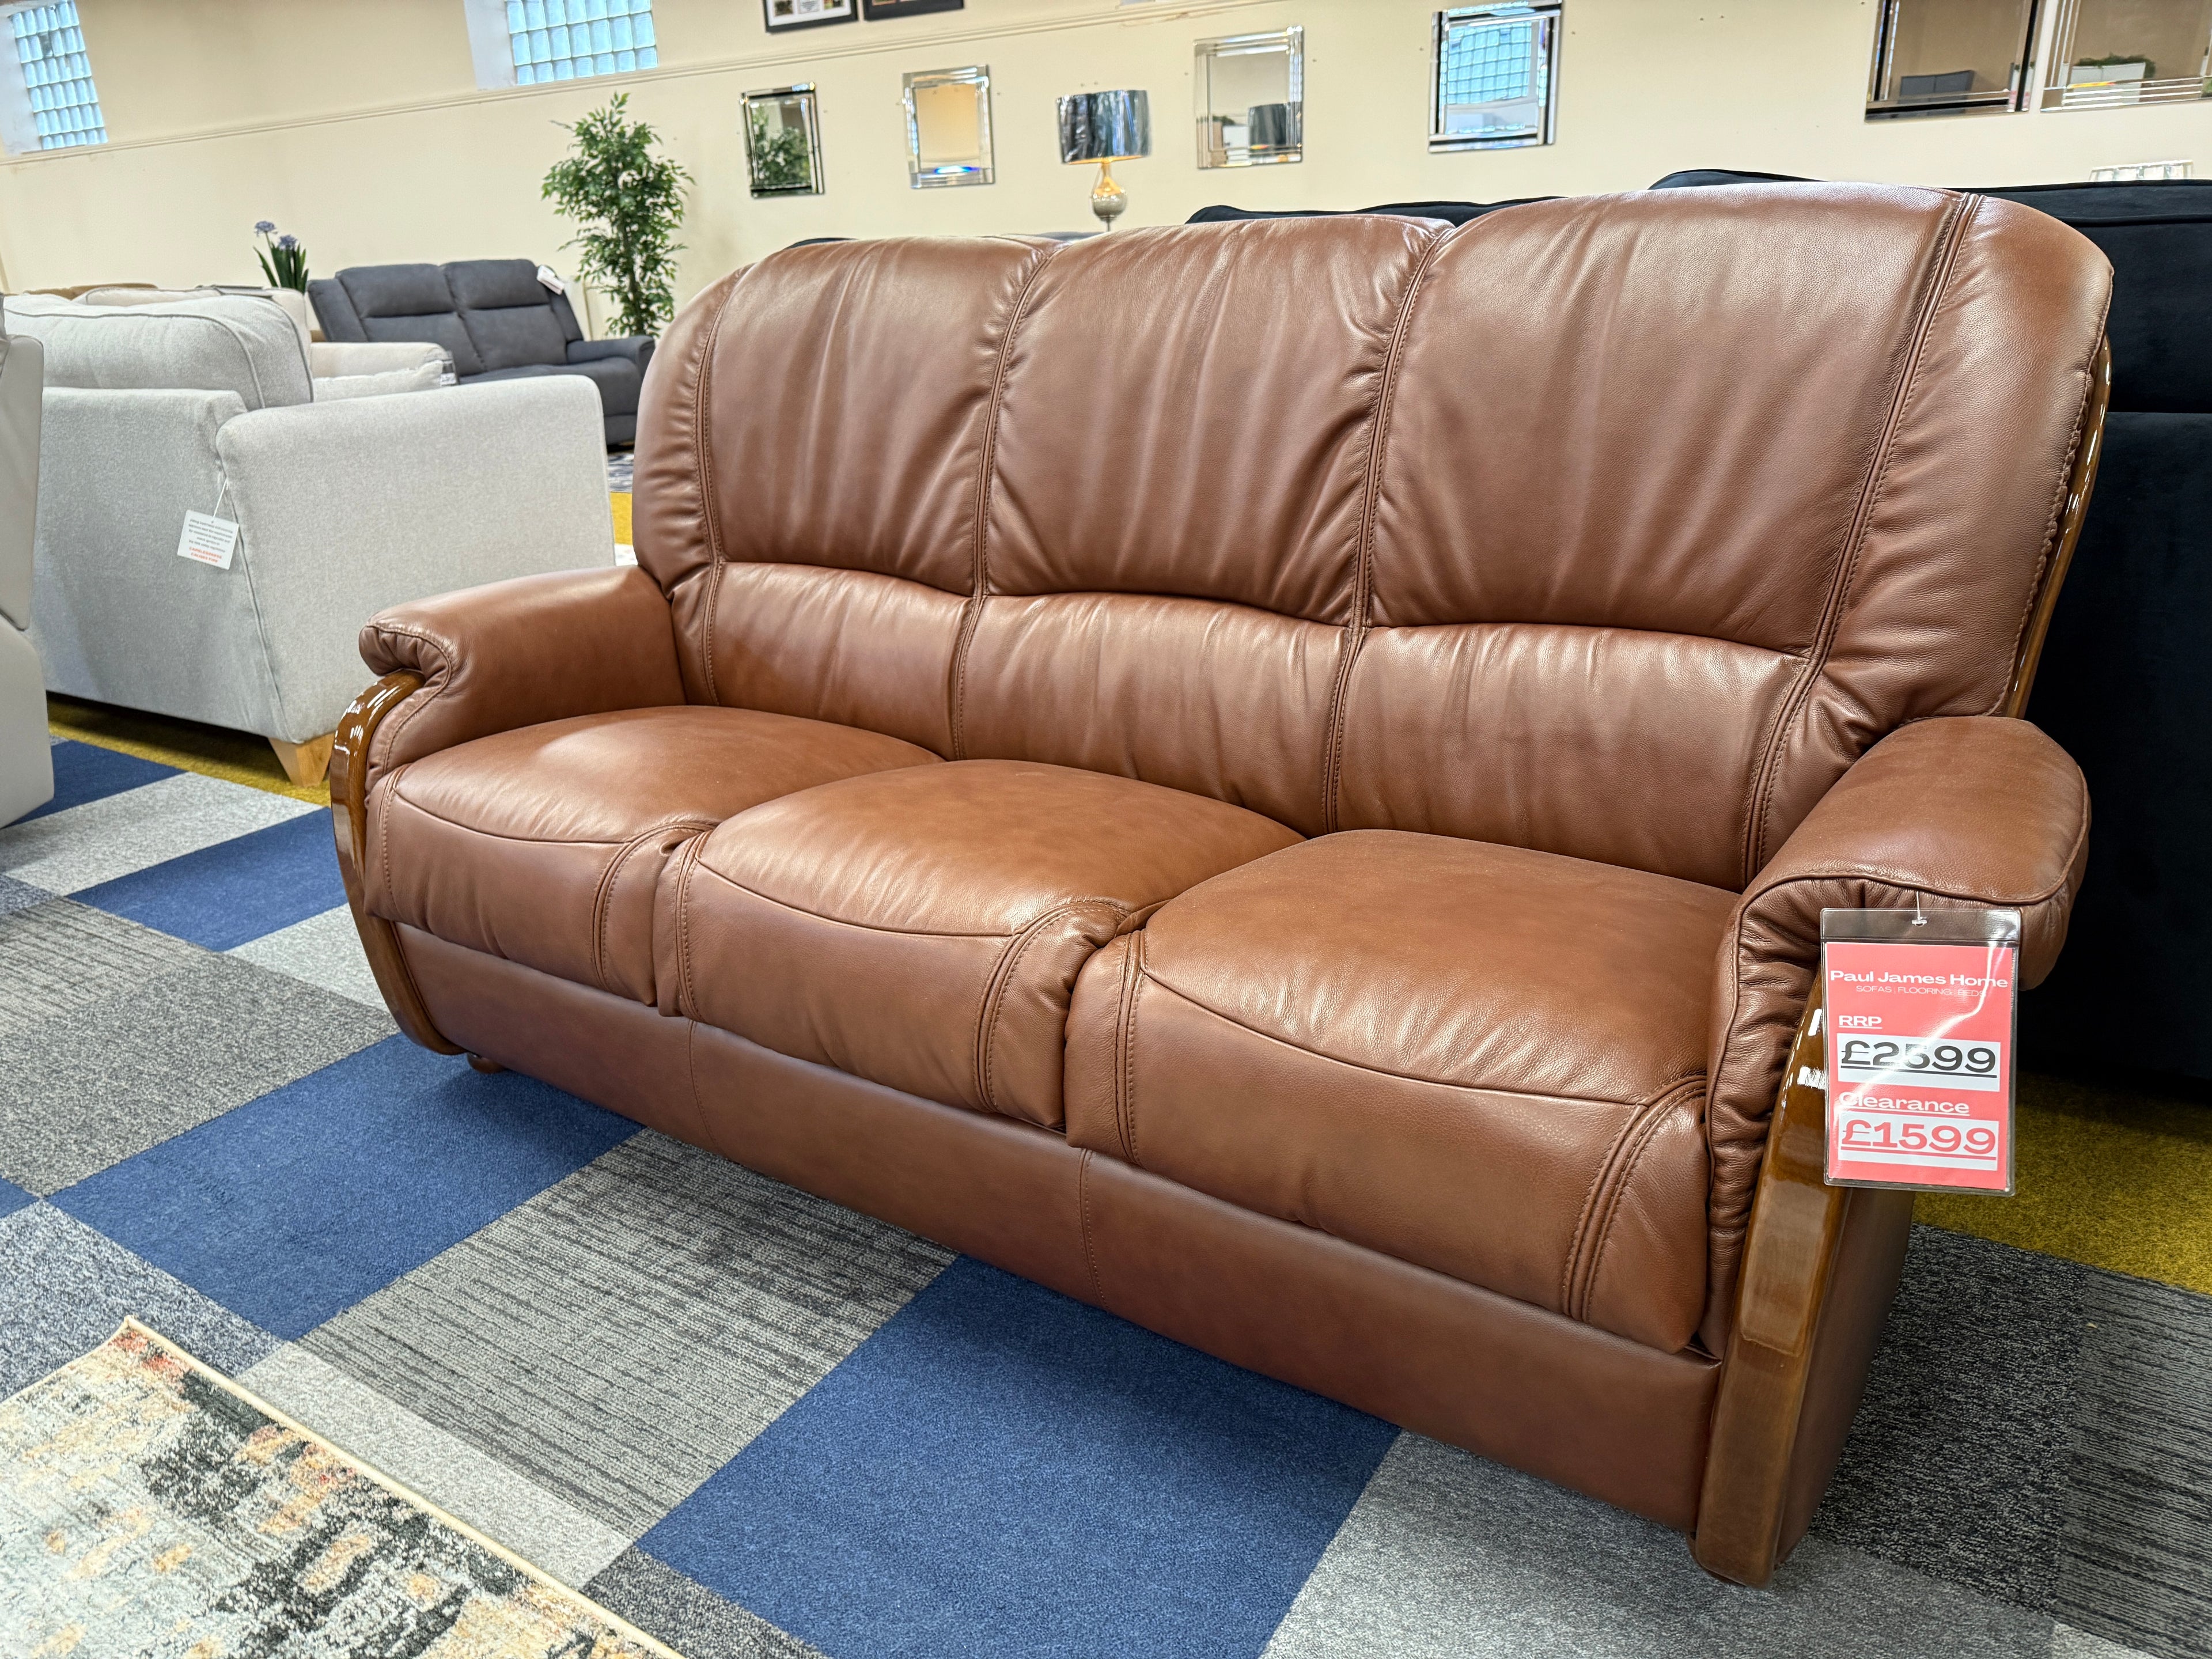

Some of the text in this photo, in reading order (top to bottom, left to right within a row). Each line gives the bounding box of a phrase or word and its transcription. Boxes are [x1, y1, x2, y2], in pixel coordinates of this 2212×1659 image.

[1830, 970, 2008, 988] Paul James Home
[1856, 985, 1986, 997] SOFAS FLOORING BEDS
[1839, 1015, 1882, 1027] RRP
[1841, 1040, 1996, 1073] £2599
[1839, 1092, 1969, 1113] Clearance
[1842, 1119, 1996, 1154] £1599
